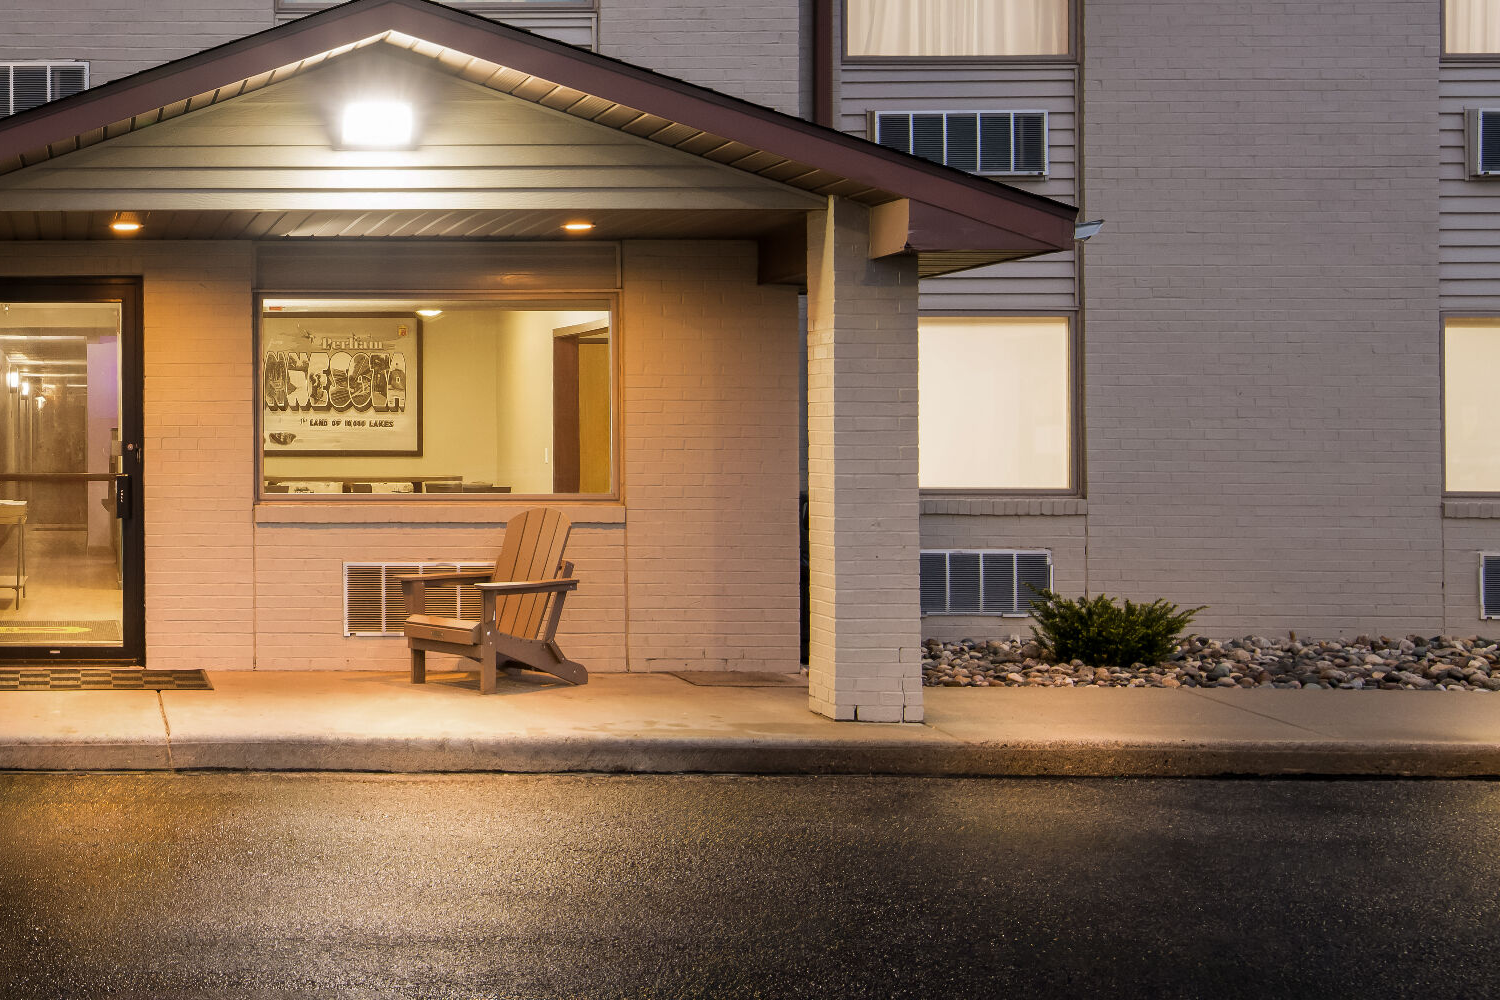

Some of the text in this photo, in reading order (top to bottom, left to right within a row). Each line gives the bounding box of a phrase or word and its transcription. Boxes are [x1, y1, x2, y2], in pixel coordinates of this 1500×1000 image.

[321, 337, 384, 350] Perham
[264, 351, 406, 411] NNESOTA
[309, 419, 328, 427] LAND
[331, 419, 342, 427] OF
[369, 420, 394, 428] LAKES
